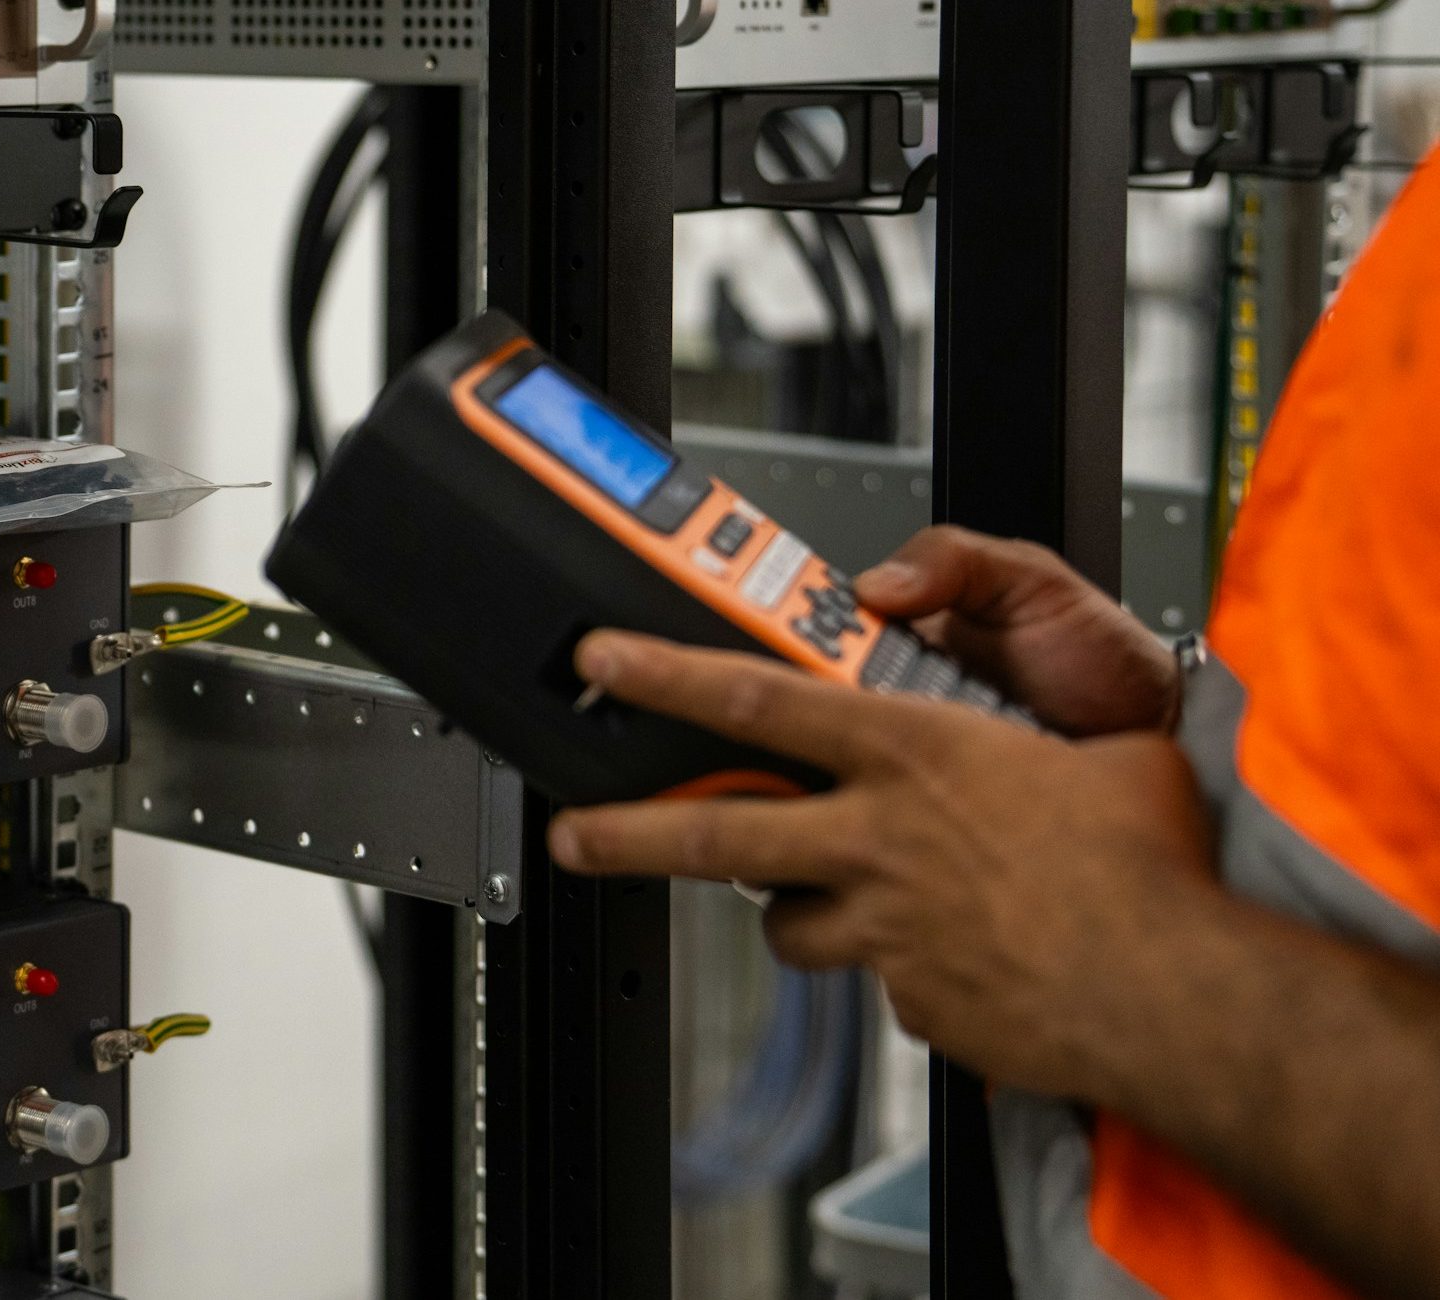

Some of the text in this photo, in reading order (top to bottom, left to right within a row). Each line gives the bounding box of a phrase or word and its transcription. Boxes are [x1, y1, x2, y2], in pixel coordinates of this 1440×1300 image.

[13, 595, 37, 609] OUT8
[89, 617, 109, 629] GND
[14, 1000, 37, 1014] OUT8
